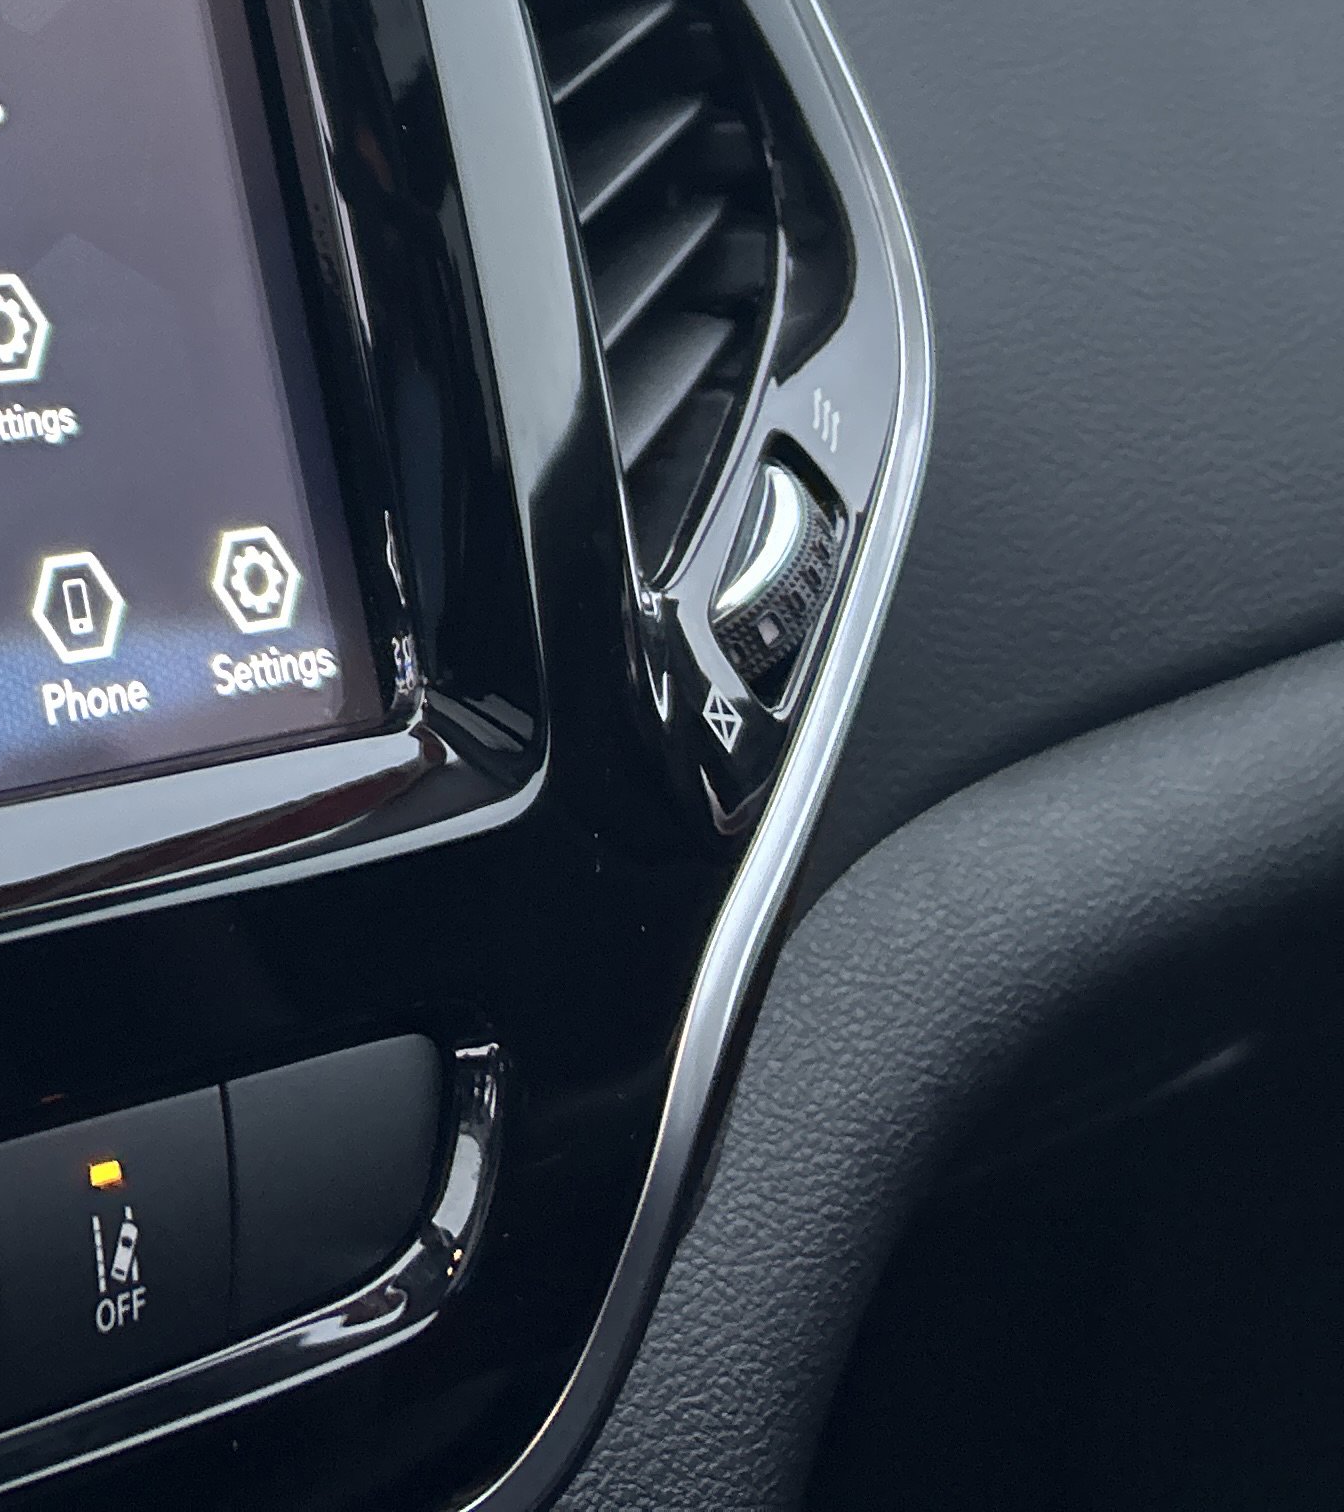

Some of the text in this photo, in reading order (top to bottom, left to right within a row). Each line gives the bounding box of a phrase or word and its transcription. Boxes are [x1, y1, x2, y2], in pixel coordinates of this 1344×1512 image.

[213, 645, 337, 696] Settings
[41, 678, 151, 727] Phone
[96, 1286, 146, 1332] OFF
